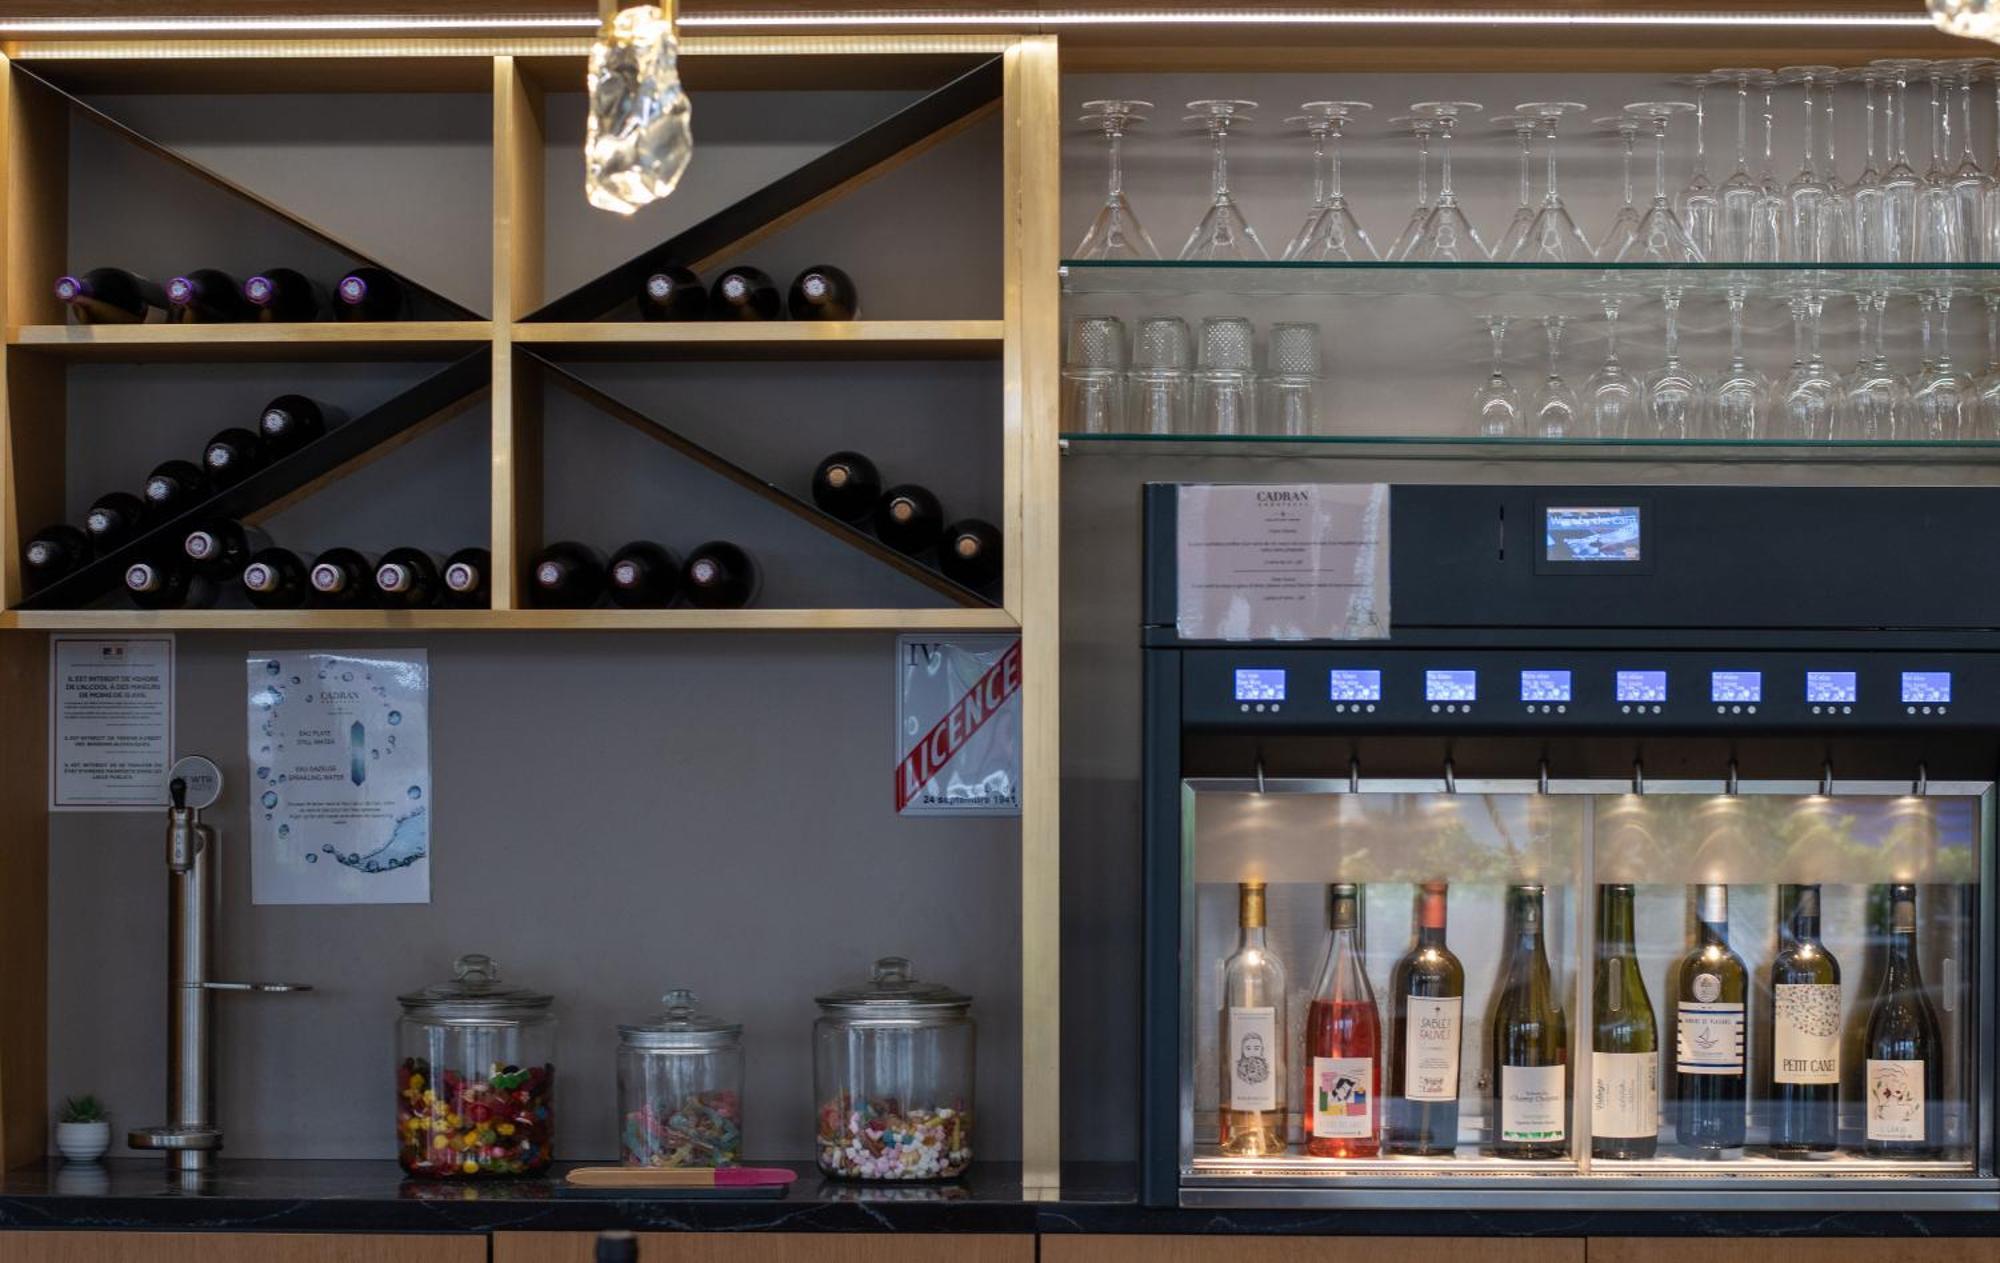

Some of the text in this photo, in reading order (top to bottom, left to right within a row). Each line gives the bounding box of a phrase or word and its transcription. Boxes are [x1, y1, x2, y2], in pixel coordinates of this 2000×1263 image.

[1256, 490, 1309, 501] CADRAN
[903, 647, 1018, 797] LICENCE
[1783, 1058, 1808, 1072] PETIT
